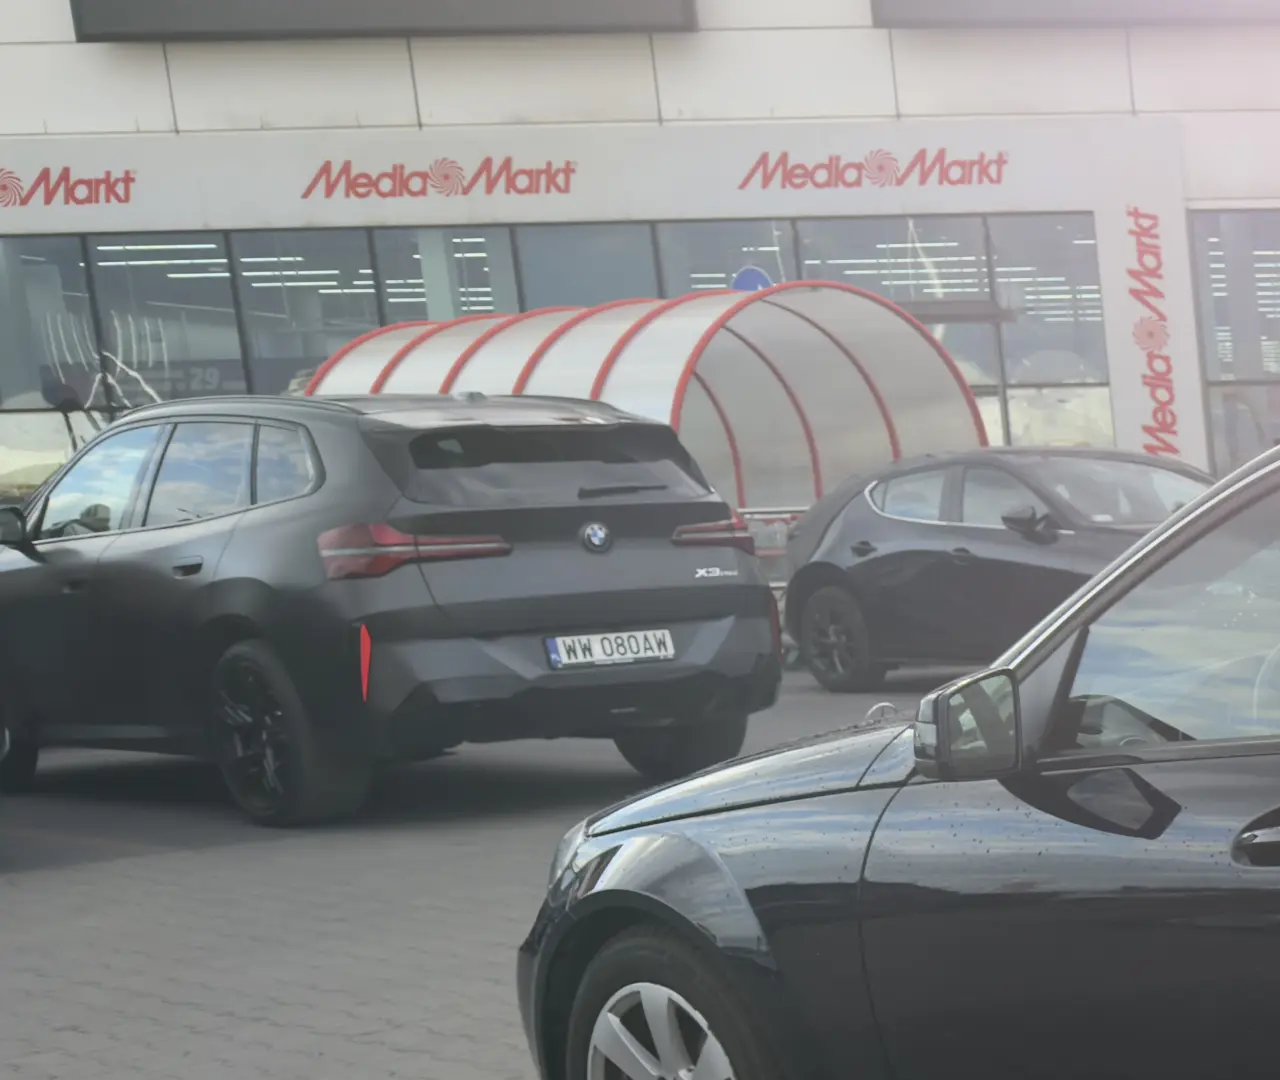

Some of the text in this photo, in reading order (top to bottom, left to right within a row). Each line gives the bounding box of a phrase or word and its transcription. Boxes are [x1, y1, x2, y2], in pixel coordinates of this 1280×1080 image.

[19, 166, 136, 206] Markt
[300, 156, 577, 199] Media Markt
[737, 147, 1008, 190] Media Markt
[1125, 205, 1180, 456] Media Markt
[694, 567, 720, 578] X3
[562, 637, 593, 661] WW
[600, 632, 669, 657] 080AW
